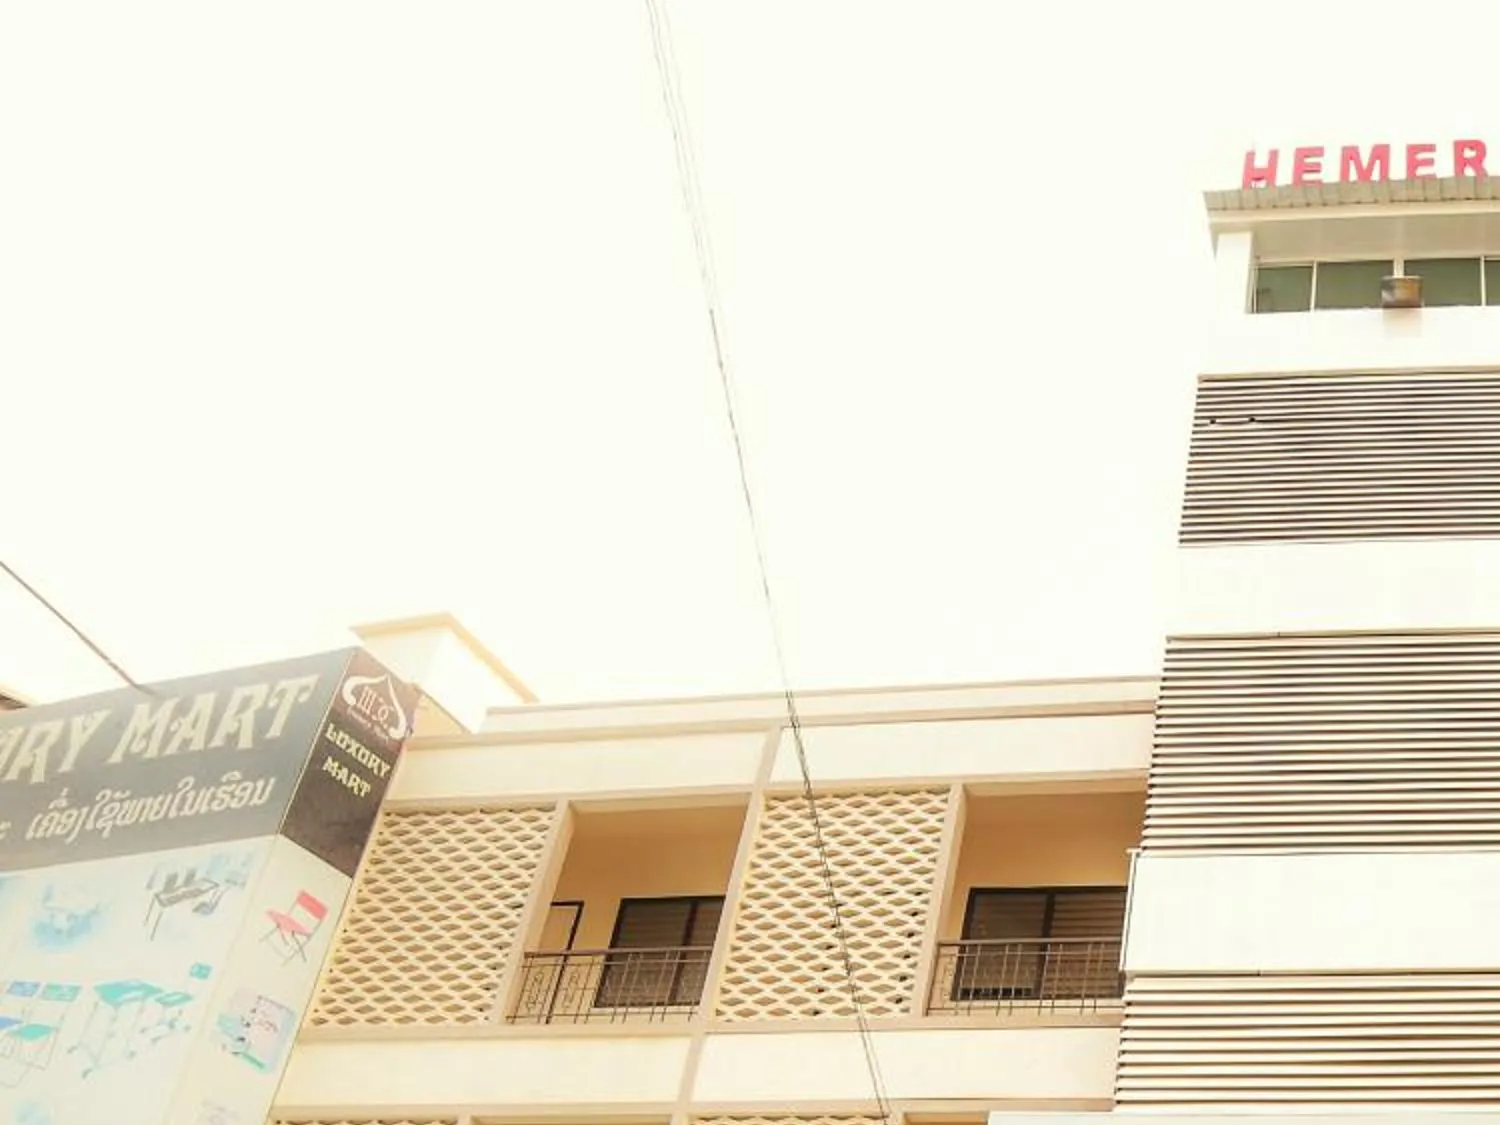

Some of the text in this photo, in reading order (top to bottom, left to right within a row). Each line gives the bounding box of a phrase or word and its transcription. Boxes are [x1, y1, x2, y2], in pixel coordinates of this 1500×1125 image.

[107, 674, 321, 765] MART
[322, 755, 372, 798] MART
[324, 722, 391, 779] LUXURY
